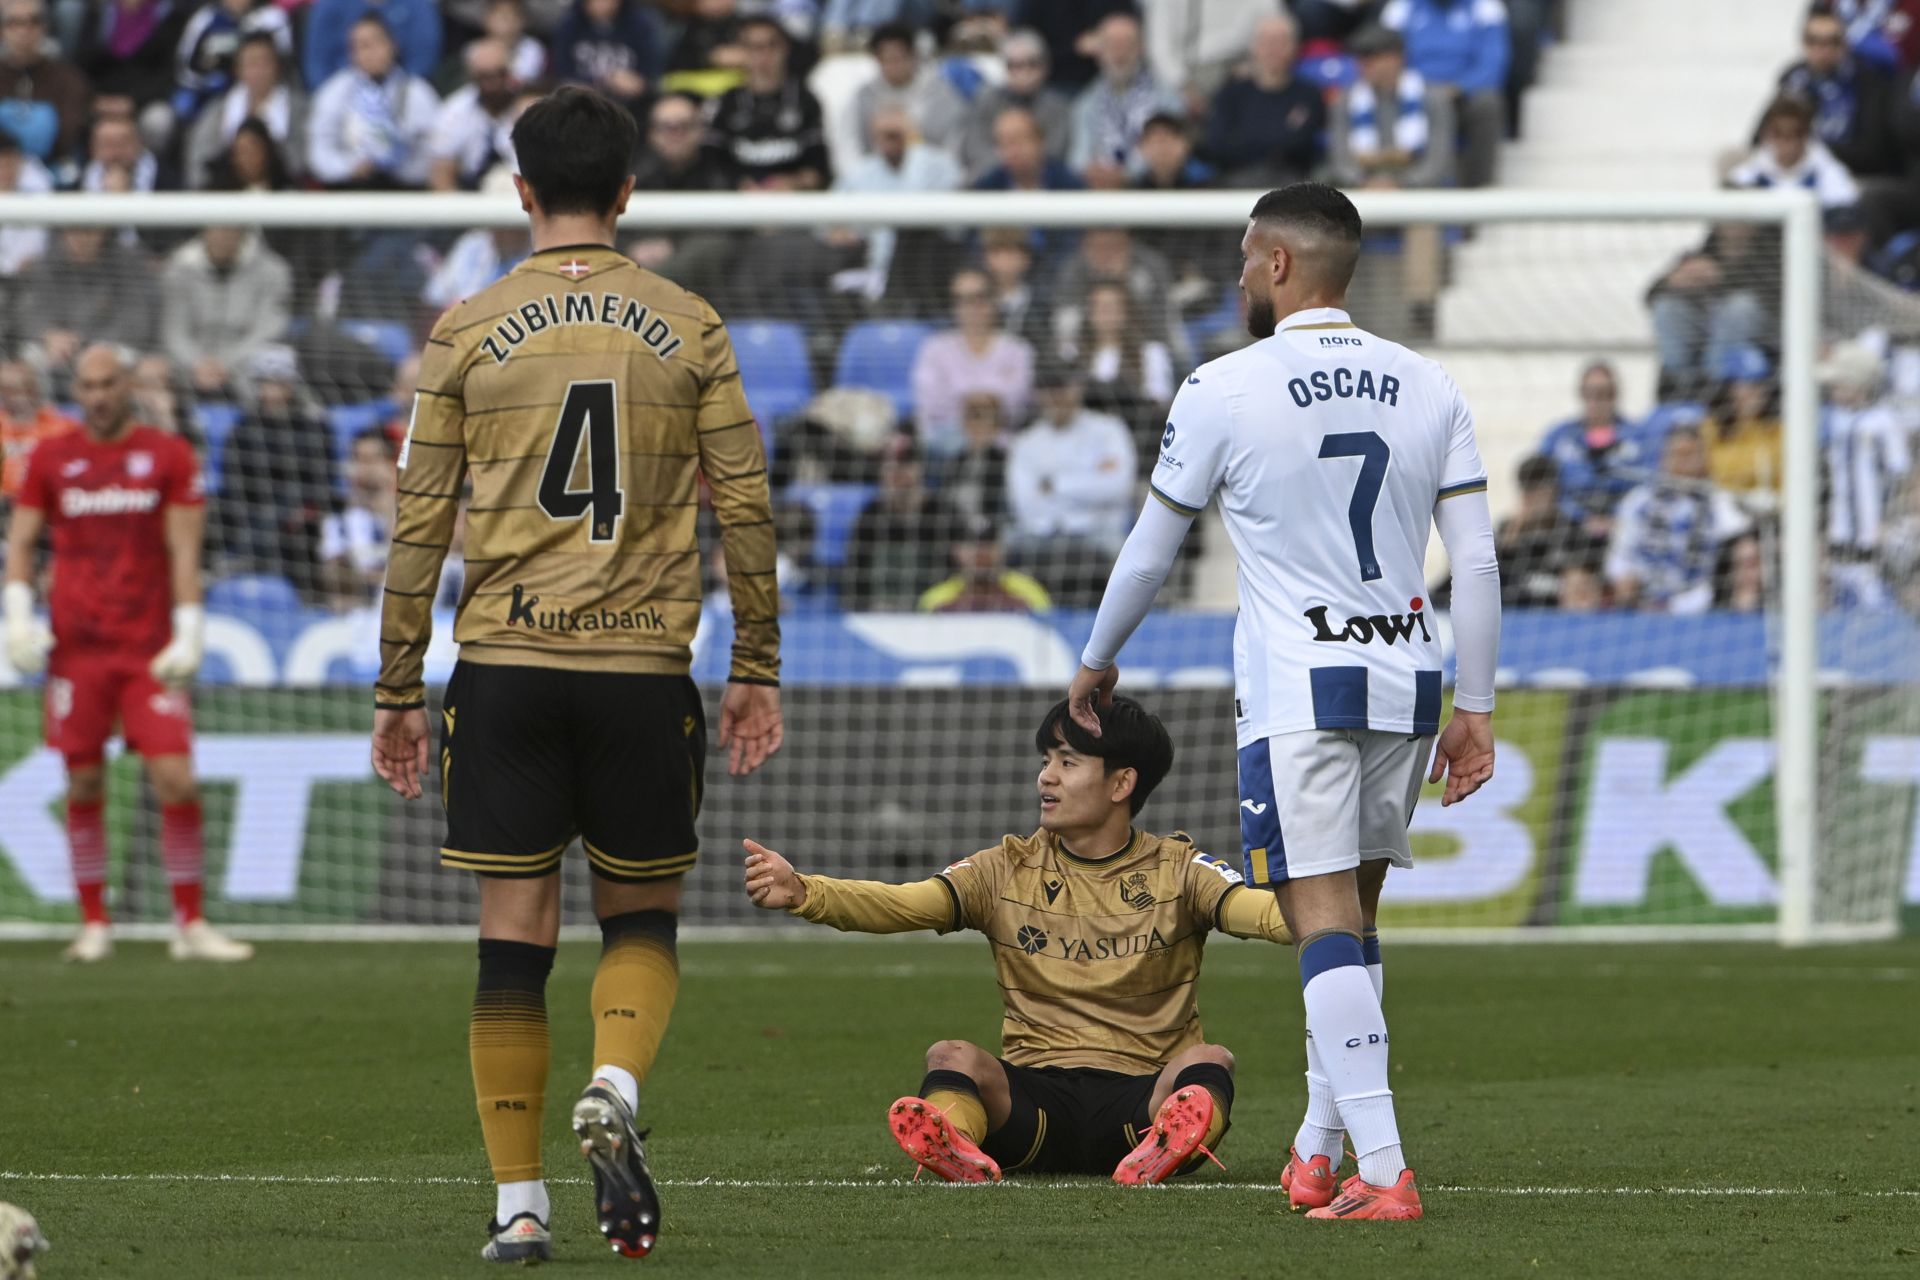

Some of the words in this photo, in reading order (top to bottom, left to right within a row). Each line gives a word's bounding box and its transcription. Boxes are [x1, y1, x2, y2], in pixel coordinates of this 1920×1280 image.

[481, 293, 682, 364] ZUBIMENDI
[1319, 336, 1363, 346] nara
[1288, 367, 1400, 408] OSCAR
[537, 379, 625, 543] 4
[1317, 431, 1390, 582] 7
[506, 584, 667, 632] Kutxabank
[1303, 596, 1432, 646] Lowi
[1058, 926, 1169, 960] YASUDA
[495, 1100, 527, 1111] RS
